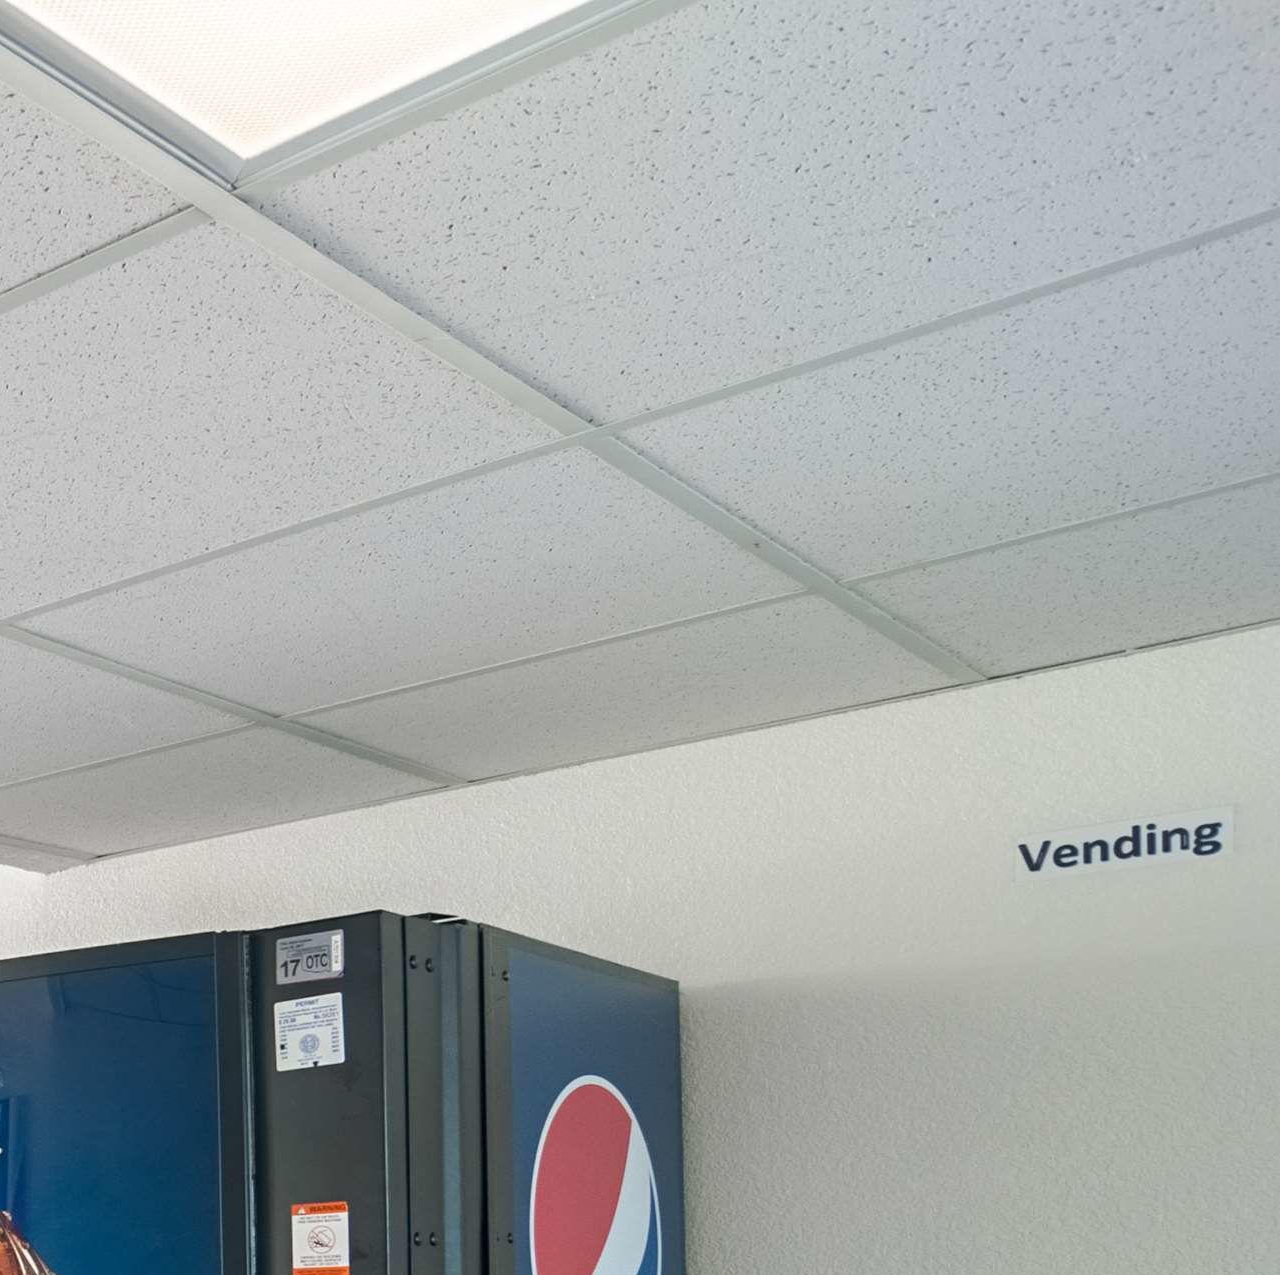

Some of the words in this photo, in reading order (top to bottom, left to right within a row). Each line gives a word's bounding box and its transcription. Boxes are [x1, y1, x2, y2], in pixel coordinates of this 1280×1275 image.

[1017, 821, 1223, 872] Vending
[281, 959, 300, 978] 17
[306, 953, 328, 970] OTC
